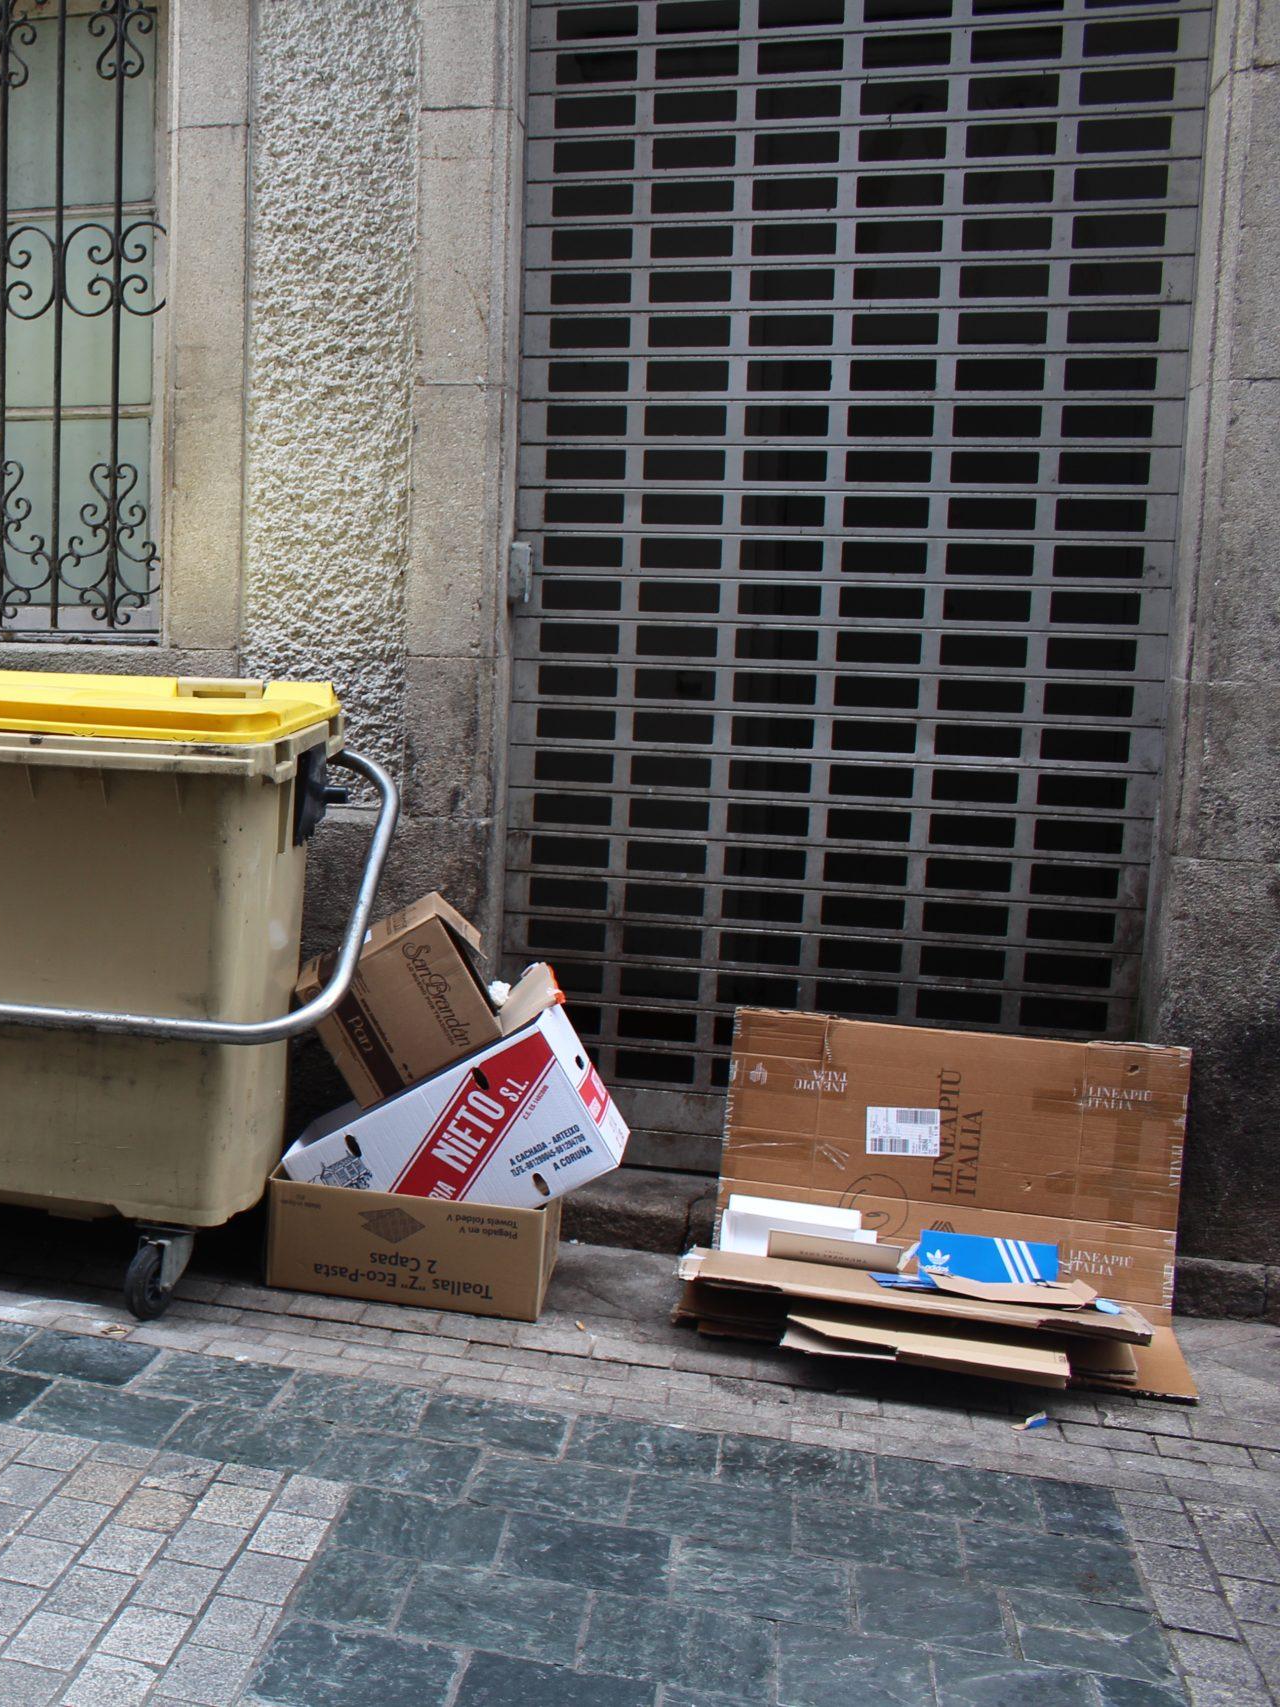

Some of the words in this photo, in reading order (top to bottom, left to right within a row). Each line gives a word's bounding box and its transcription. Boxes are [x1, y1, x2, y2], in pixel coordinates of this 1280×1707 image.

[402, 941, 433, 979] San
[347, 1015, 374, 1052] Pan
[1088, 1097, 1132, 1111] ITALIA
[508, 1157, 516, 1167] A
[515, 1141, 548, 1163] CACHADA
[551, 1124, 580, 1143] ARTEIXO
[955, 1110, 983, 1197] ITALIA
[552, 1161, 561, 1171] A
[559, 1144, 593, 1167] CORUÑA
[455, 1214, 485, 1225] folded
[490, 1217, 518, 1228] Towels
[468, 1227, 480, 1235] en
[370, 1252, 420, 1272] Capas
[427, 1260, 437, 1273] 2
[314, 1263, 397, 1287] Eco-Pasta
[432, 1278, 493, 1299] Toallas
